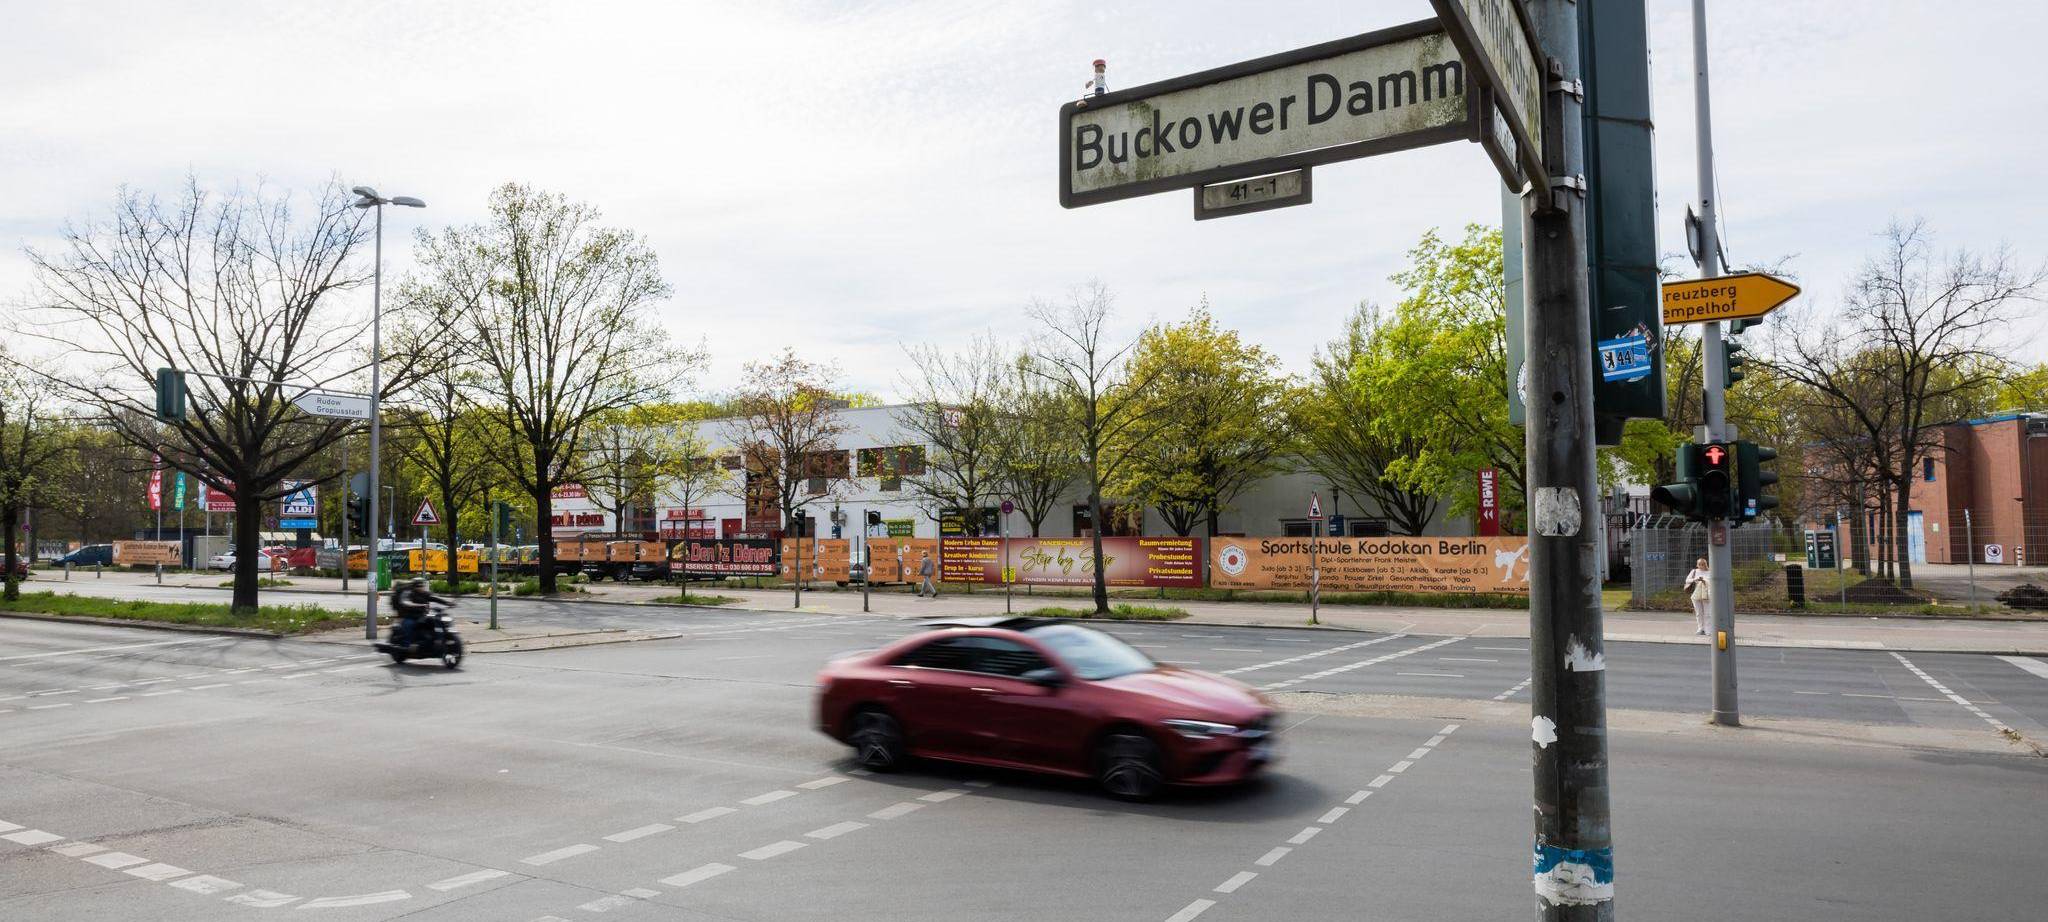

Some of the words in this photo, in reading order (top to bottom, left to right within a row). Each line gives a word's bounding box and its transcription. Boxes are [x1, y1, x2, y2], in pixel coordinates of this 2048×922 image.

[1076, 94, 1298, 171] Buckower
[1307, 60, 1464, 125] Damm
[1231, 182, 1250, 200] 41
[1269, 178, 1277, 196] 1
[1662, 284, 1737, 302] reuzberg
[1662, 300, 1737, 320] empelhof
[1617, 350, 1633, 366] 44
[316, 397, 342, 406] Rudow
[316, 406, 363, 416] Gropiusstadt
[1481, 470, 1494, 508] REWE
[286, 506, 313, 514] ALDI
[733, 542, 773, 563] Döner
[1261, 540, 1351, 556] Sportschule
[1359, 541, 1432, 555] Kodokan
[1439, 541, 1487, 555] Berlin
[671, 562, 713, 571] LIEFRSERVICE
[1057, 545, 1073, 576] by
